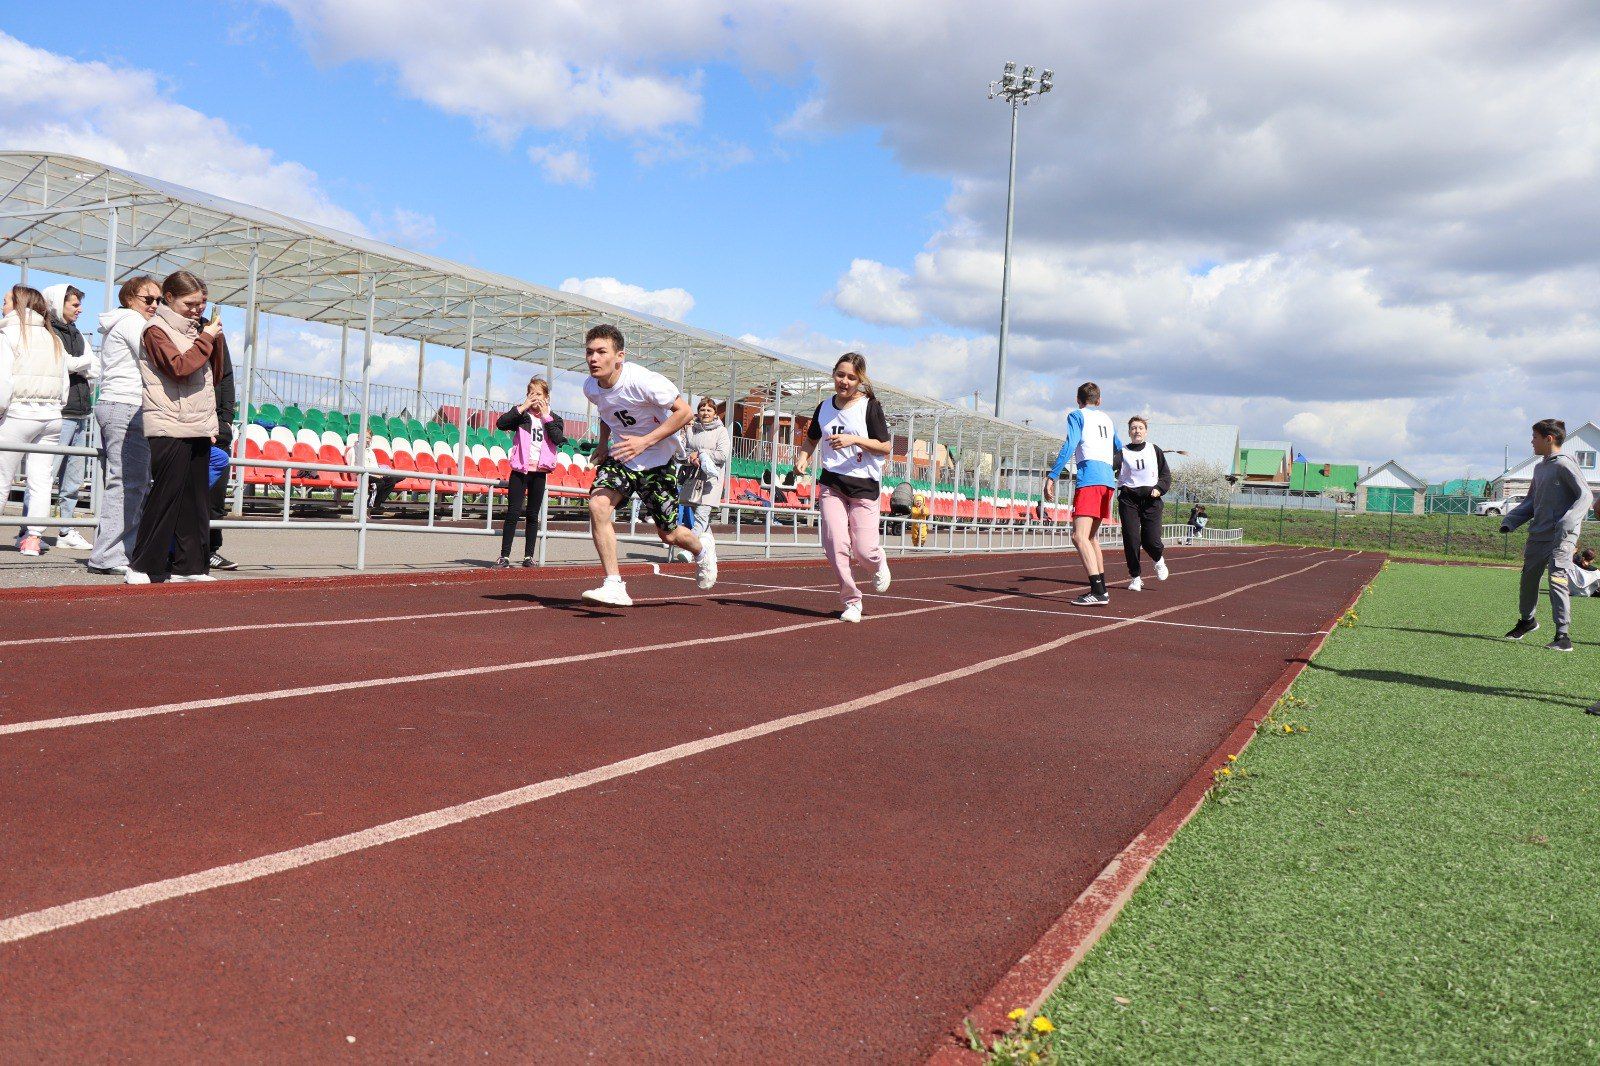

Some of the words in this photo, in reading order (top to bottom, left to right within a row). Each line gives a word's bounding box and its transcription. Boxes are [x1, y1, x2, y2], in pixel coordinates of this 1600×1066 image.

[614, 410, 637, 427] 15
[653, 416, 661, 424] 4
[532, 428, 543, 442] 15
[1098, 425, 1107, 438] 11
[856, 452, 863, 463] 3
[1135, 458, 1145, 470] 11
